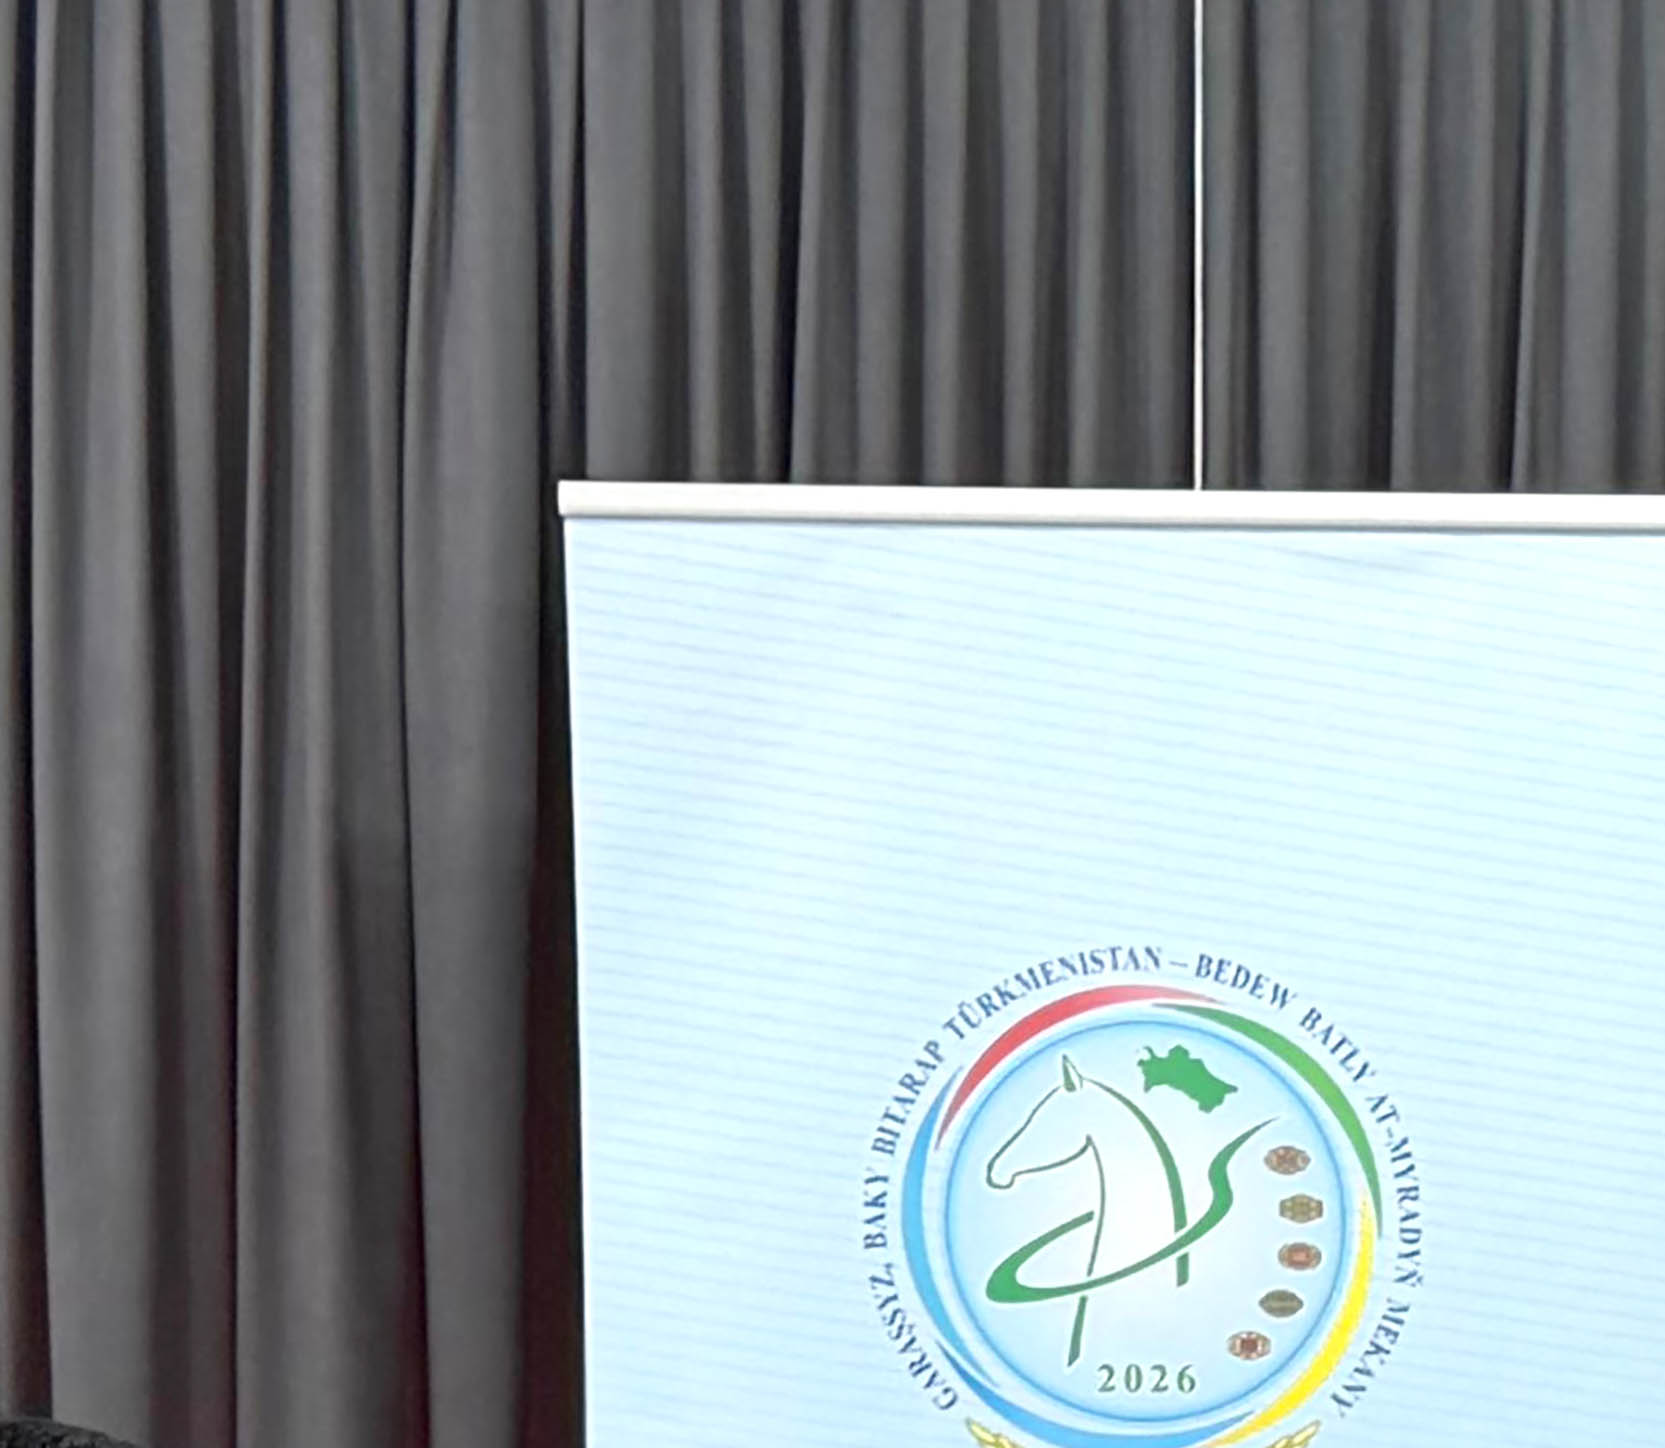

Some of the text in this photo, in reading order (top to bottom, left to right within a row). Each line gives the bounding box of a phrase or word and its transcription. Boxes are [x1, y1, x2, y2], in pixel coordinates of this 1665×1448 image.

[942, 945, 1163, 1041] TÜRKMENISTAN
[1194, 952, 1298, 1010] BEDEW
[1298, 1006, 1377, 1083] BATLY
[870, 1039, 946, 1156] BITARAP
[862, 1166, 890, 1250] BAKY
[1097, 1363, 1197, 1393] 2026
[1329, 1297, 1411, 1418] MEKANY
